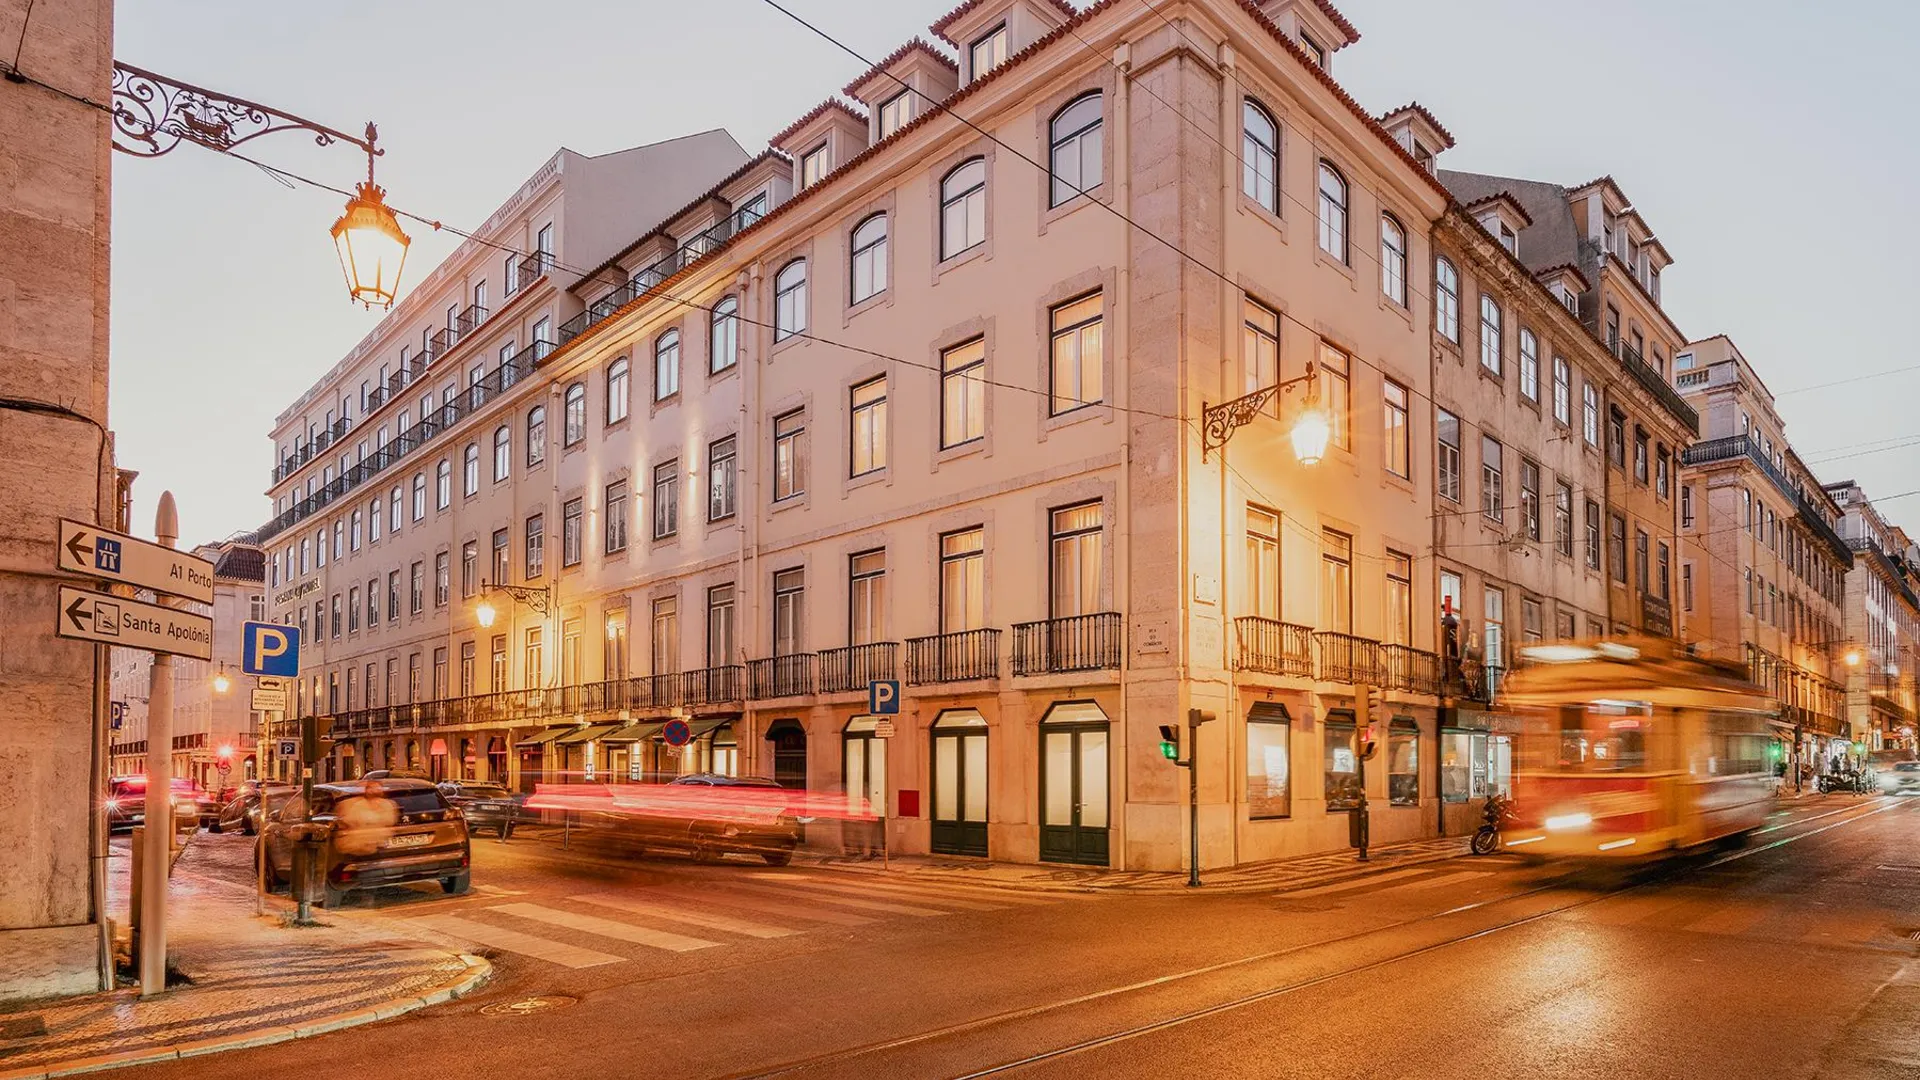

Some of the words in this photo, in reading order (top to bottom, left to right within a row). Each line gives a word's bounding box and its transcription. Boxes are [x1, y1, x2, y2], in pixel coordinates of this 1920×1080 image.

[170, 563, 183, 579] A1
[188, 568, 212, 588] Porto
[123, 612, 161, 635] Santa
[167, 622, 210, 644] Apolónia
[254, 627, 288, 671] P
[875, 683, 894, 712] P
[112, 703, 121, 727] P
